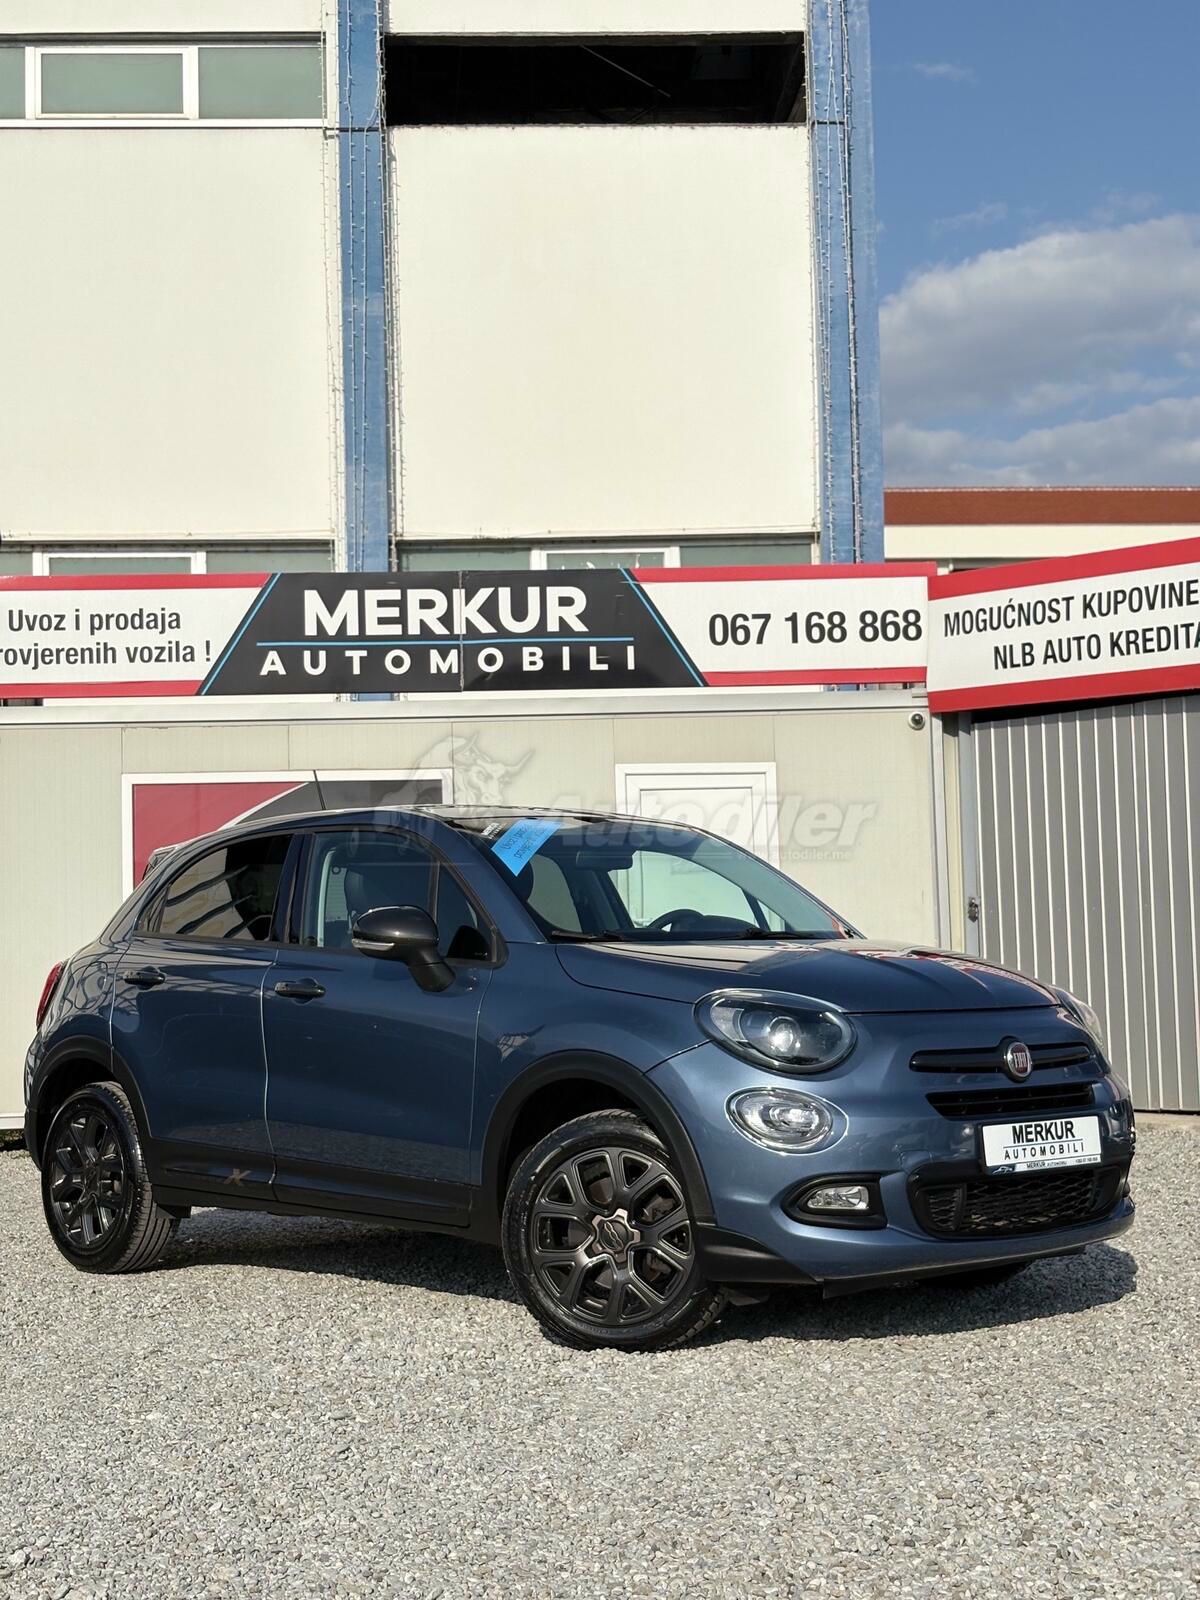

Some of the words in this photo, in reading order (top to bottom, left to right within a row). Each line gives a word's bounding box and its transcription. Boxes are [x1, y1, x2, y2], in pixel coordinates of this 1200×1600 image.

[8, 609, 67, 631] Uvoz
[75, 608, 80, 630] i
[89, 607, 181, 635] prodaja
[303, 585, 589, 637] MERKUR
[943, 598, 1075, 637] MOGUĆNOST
[1082, 579, 1199, 619] KUPOVINE
[708, 612, 772, 646] 067
[785, 611, 848, 644] 168
[858, 609, 923, 642] 868
[125, 640, 195, 663] vozila
[205, 640, 211, 662] !
[260, 646, 635, 676] AUTOMOBILI
[993, 642, 1035, 670] NLB
[1042, 634, 1101, 664] AUTO
[1011, 1120, 1076, 1144] MERKUR
[1004, 1142, 1085, 1160] AUTOMOBILI
